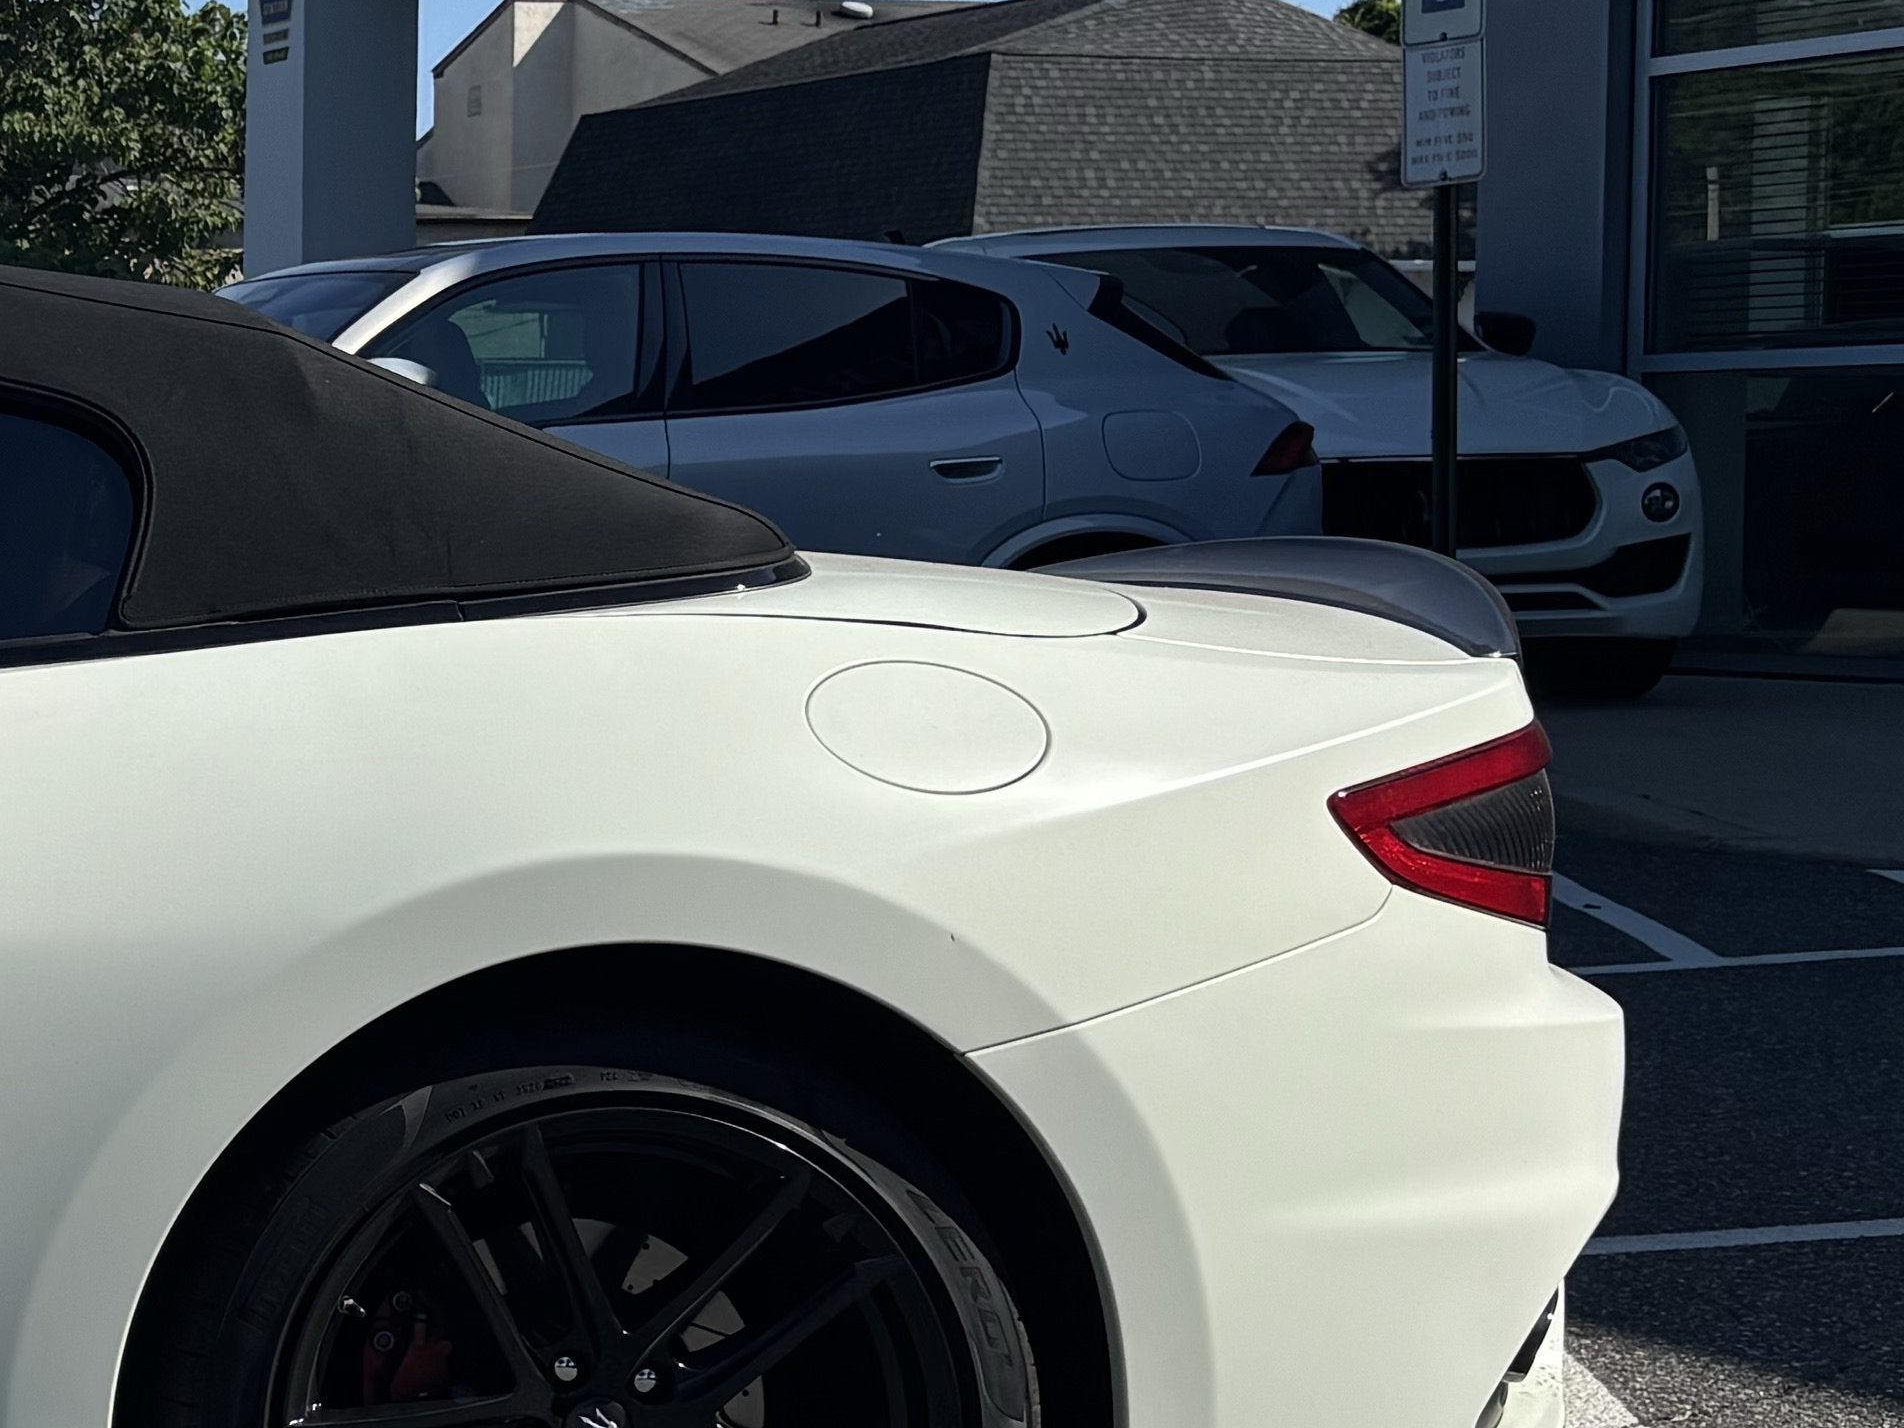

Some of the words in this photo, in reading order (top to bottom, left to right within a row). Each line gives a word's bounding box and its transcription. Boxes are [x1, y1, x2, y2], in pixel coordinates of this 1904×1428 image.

[1421, 46, 1466, 64] VIOLATORS
[1426, 66, 1462, 83] SUBJECT
[1427, 88, 1438, 102] TO
[1440, 86, 1460, 100] FINE
[1418, 109, 1435, 122] AND
[1437, 104, 1472, 119] TOWING
